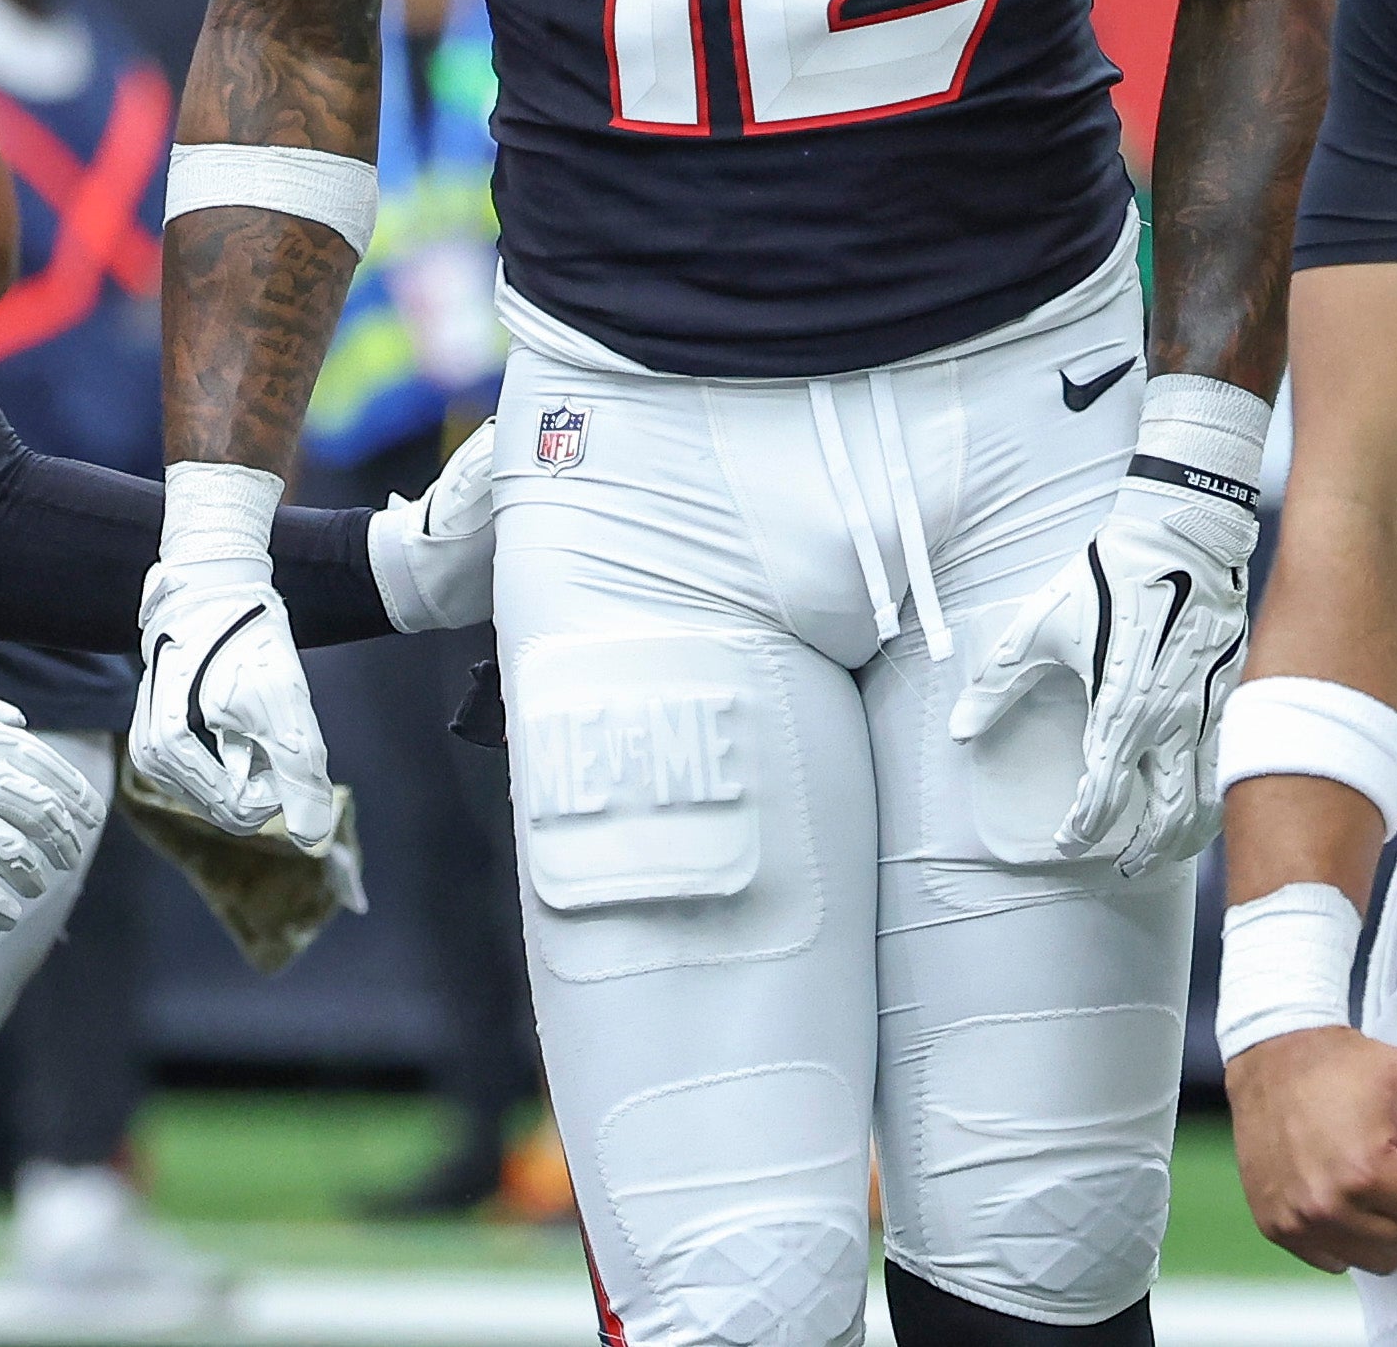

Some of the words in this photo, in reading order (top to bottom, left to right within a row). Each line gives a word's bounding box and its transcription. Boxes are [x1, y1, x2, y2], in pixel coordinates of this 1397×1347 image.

[540, 432, 576, 461] NFL
[1184, 470, 1249, 502] BETTER.
[648, 691, 745, 807] ME
